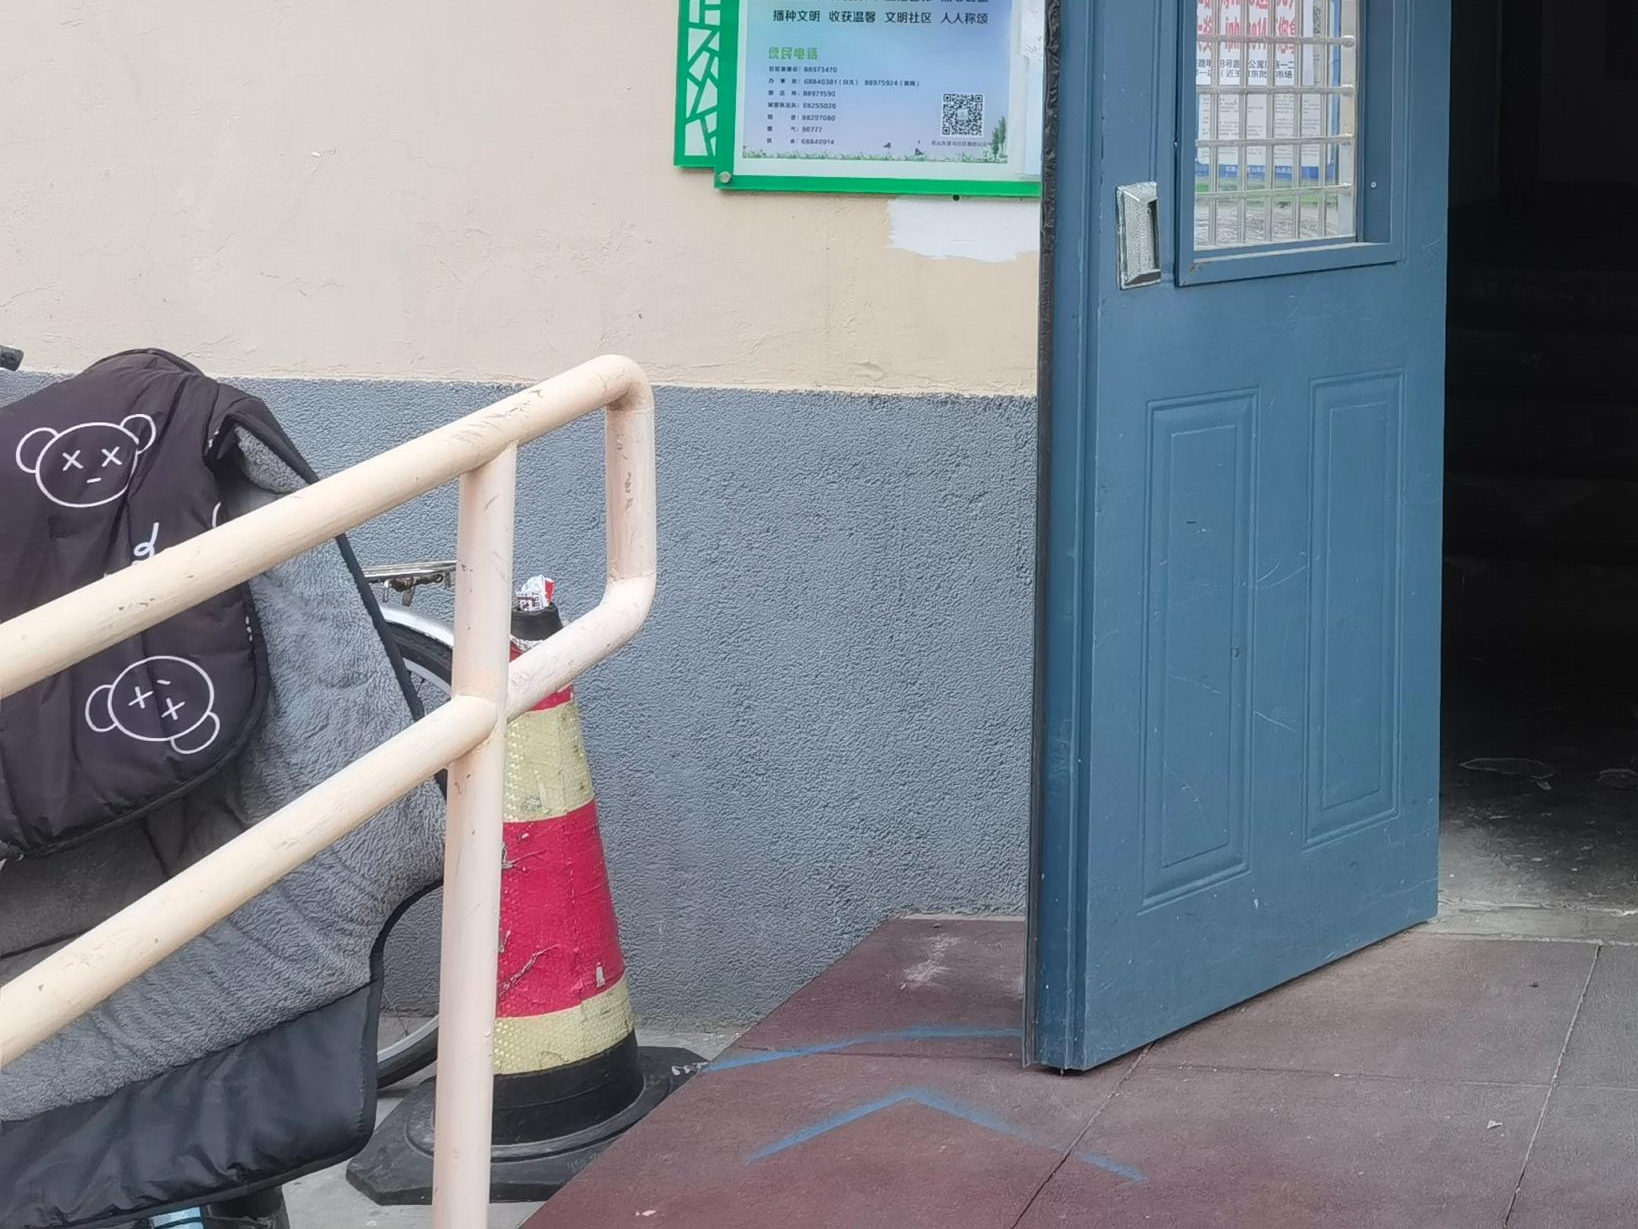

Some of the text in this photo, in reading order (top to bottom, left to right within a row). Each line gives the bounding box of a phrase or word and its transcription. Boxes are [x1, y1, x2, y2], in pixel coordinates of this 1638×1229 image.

[773, 9, 989, 24] 播种文明 收获温馨 文明社区 人人称颂
[768, 46, 818, 61] 便民电话
